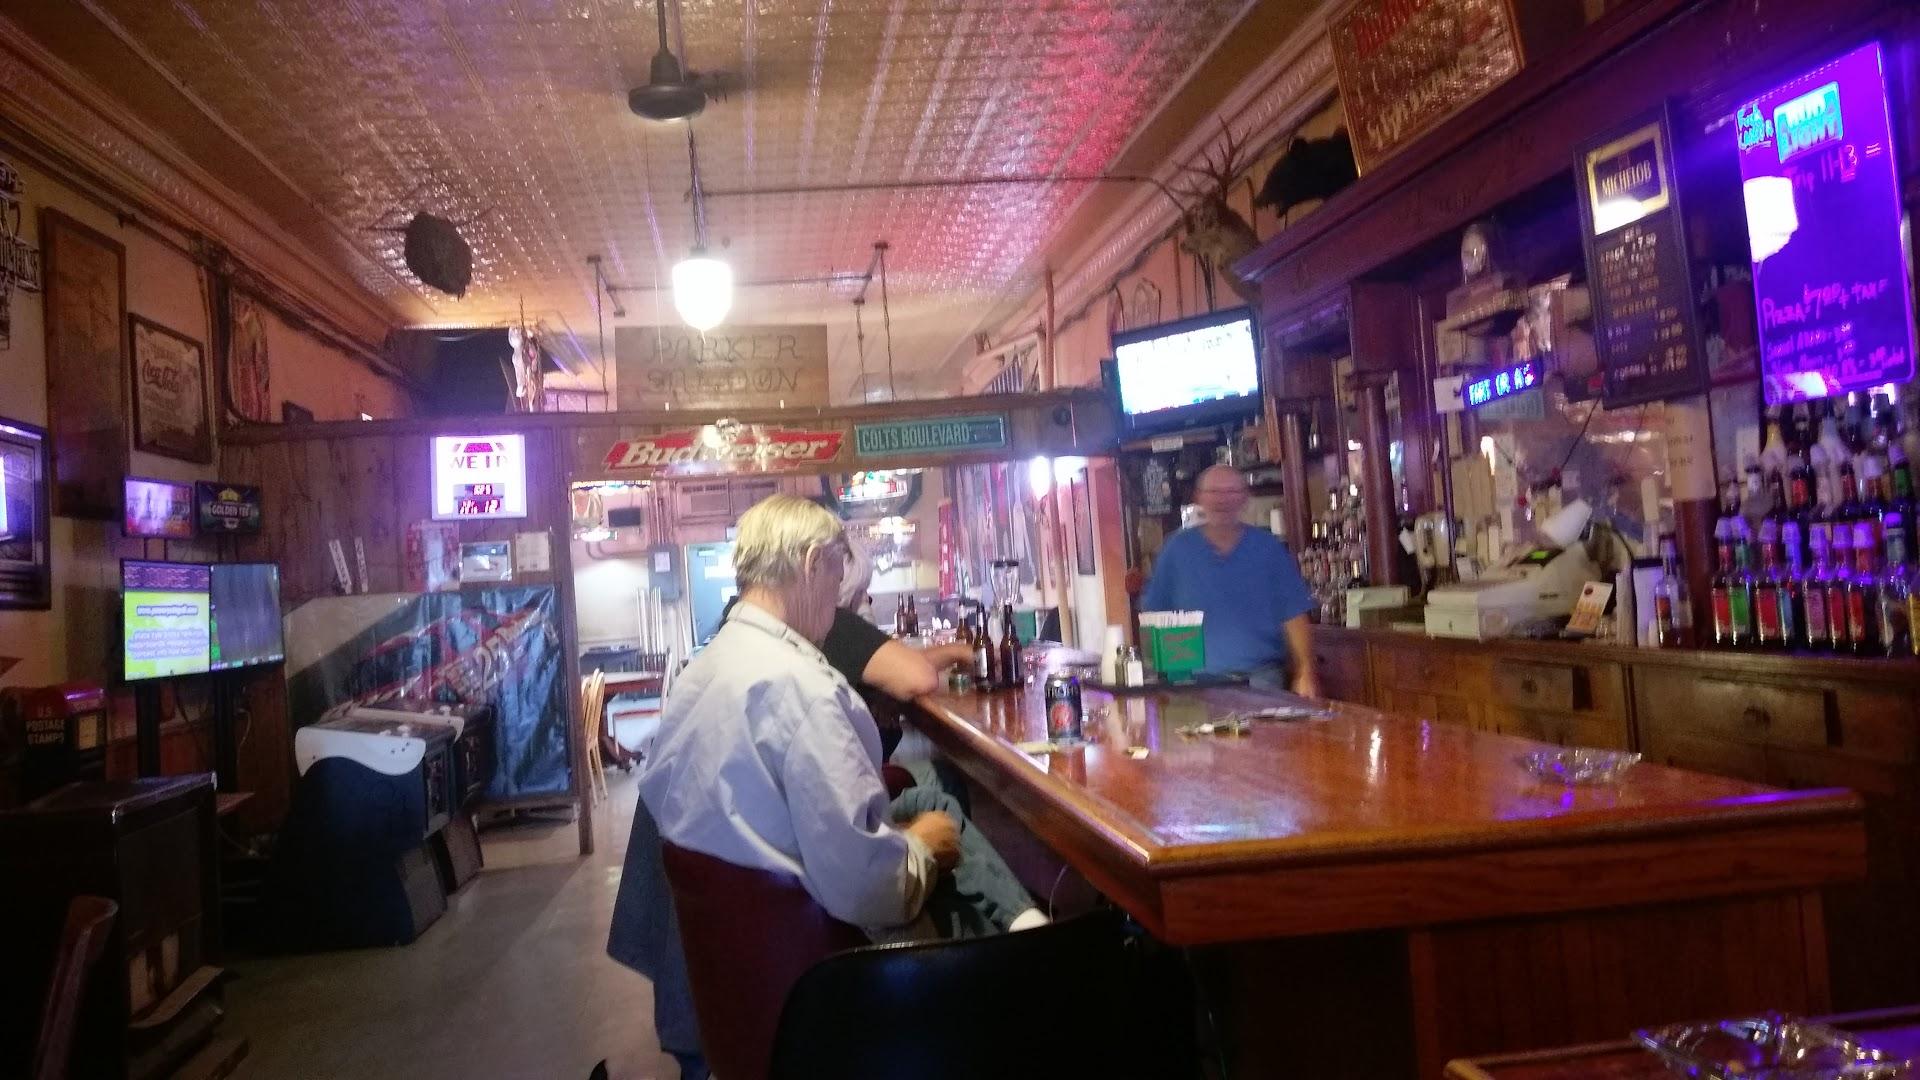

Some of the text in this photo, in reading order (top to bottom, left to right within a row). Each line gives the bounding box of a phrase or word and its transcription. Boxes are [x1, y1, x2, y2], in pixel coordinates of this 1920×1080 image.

[1601, 160, 1652, 198] MICHELOB
[648, 334, 800, 363] PARKER
[647, 367, 801, 396] SALOON
[614, 430, 829, 469] Budweiser
[861, 428, 900, 451] COLTS
[900, 423, 970, 449] BOULEVARD
[211, 503, 250, 517] GOLDEN TEE
[25, 719, 65, 732] POSTAGE
[27, 733, 65, 745] STAMPS
